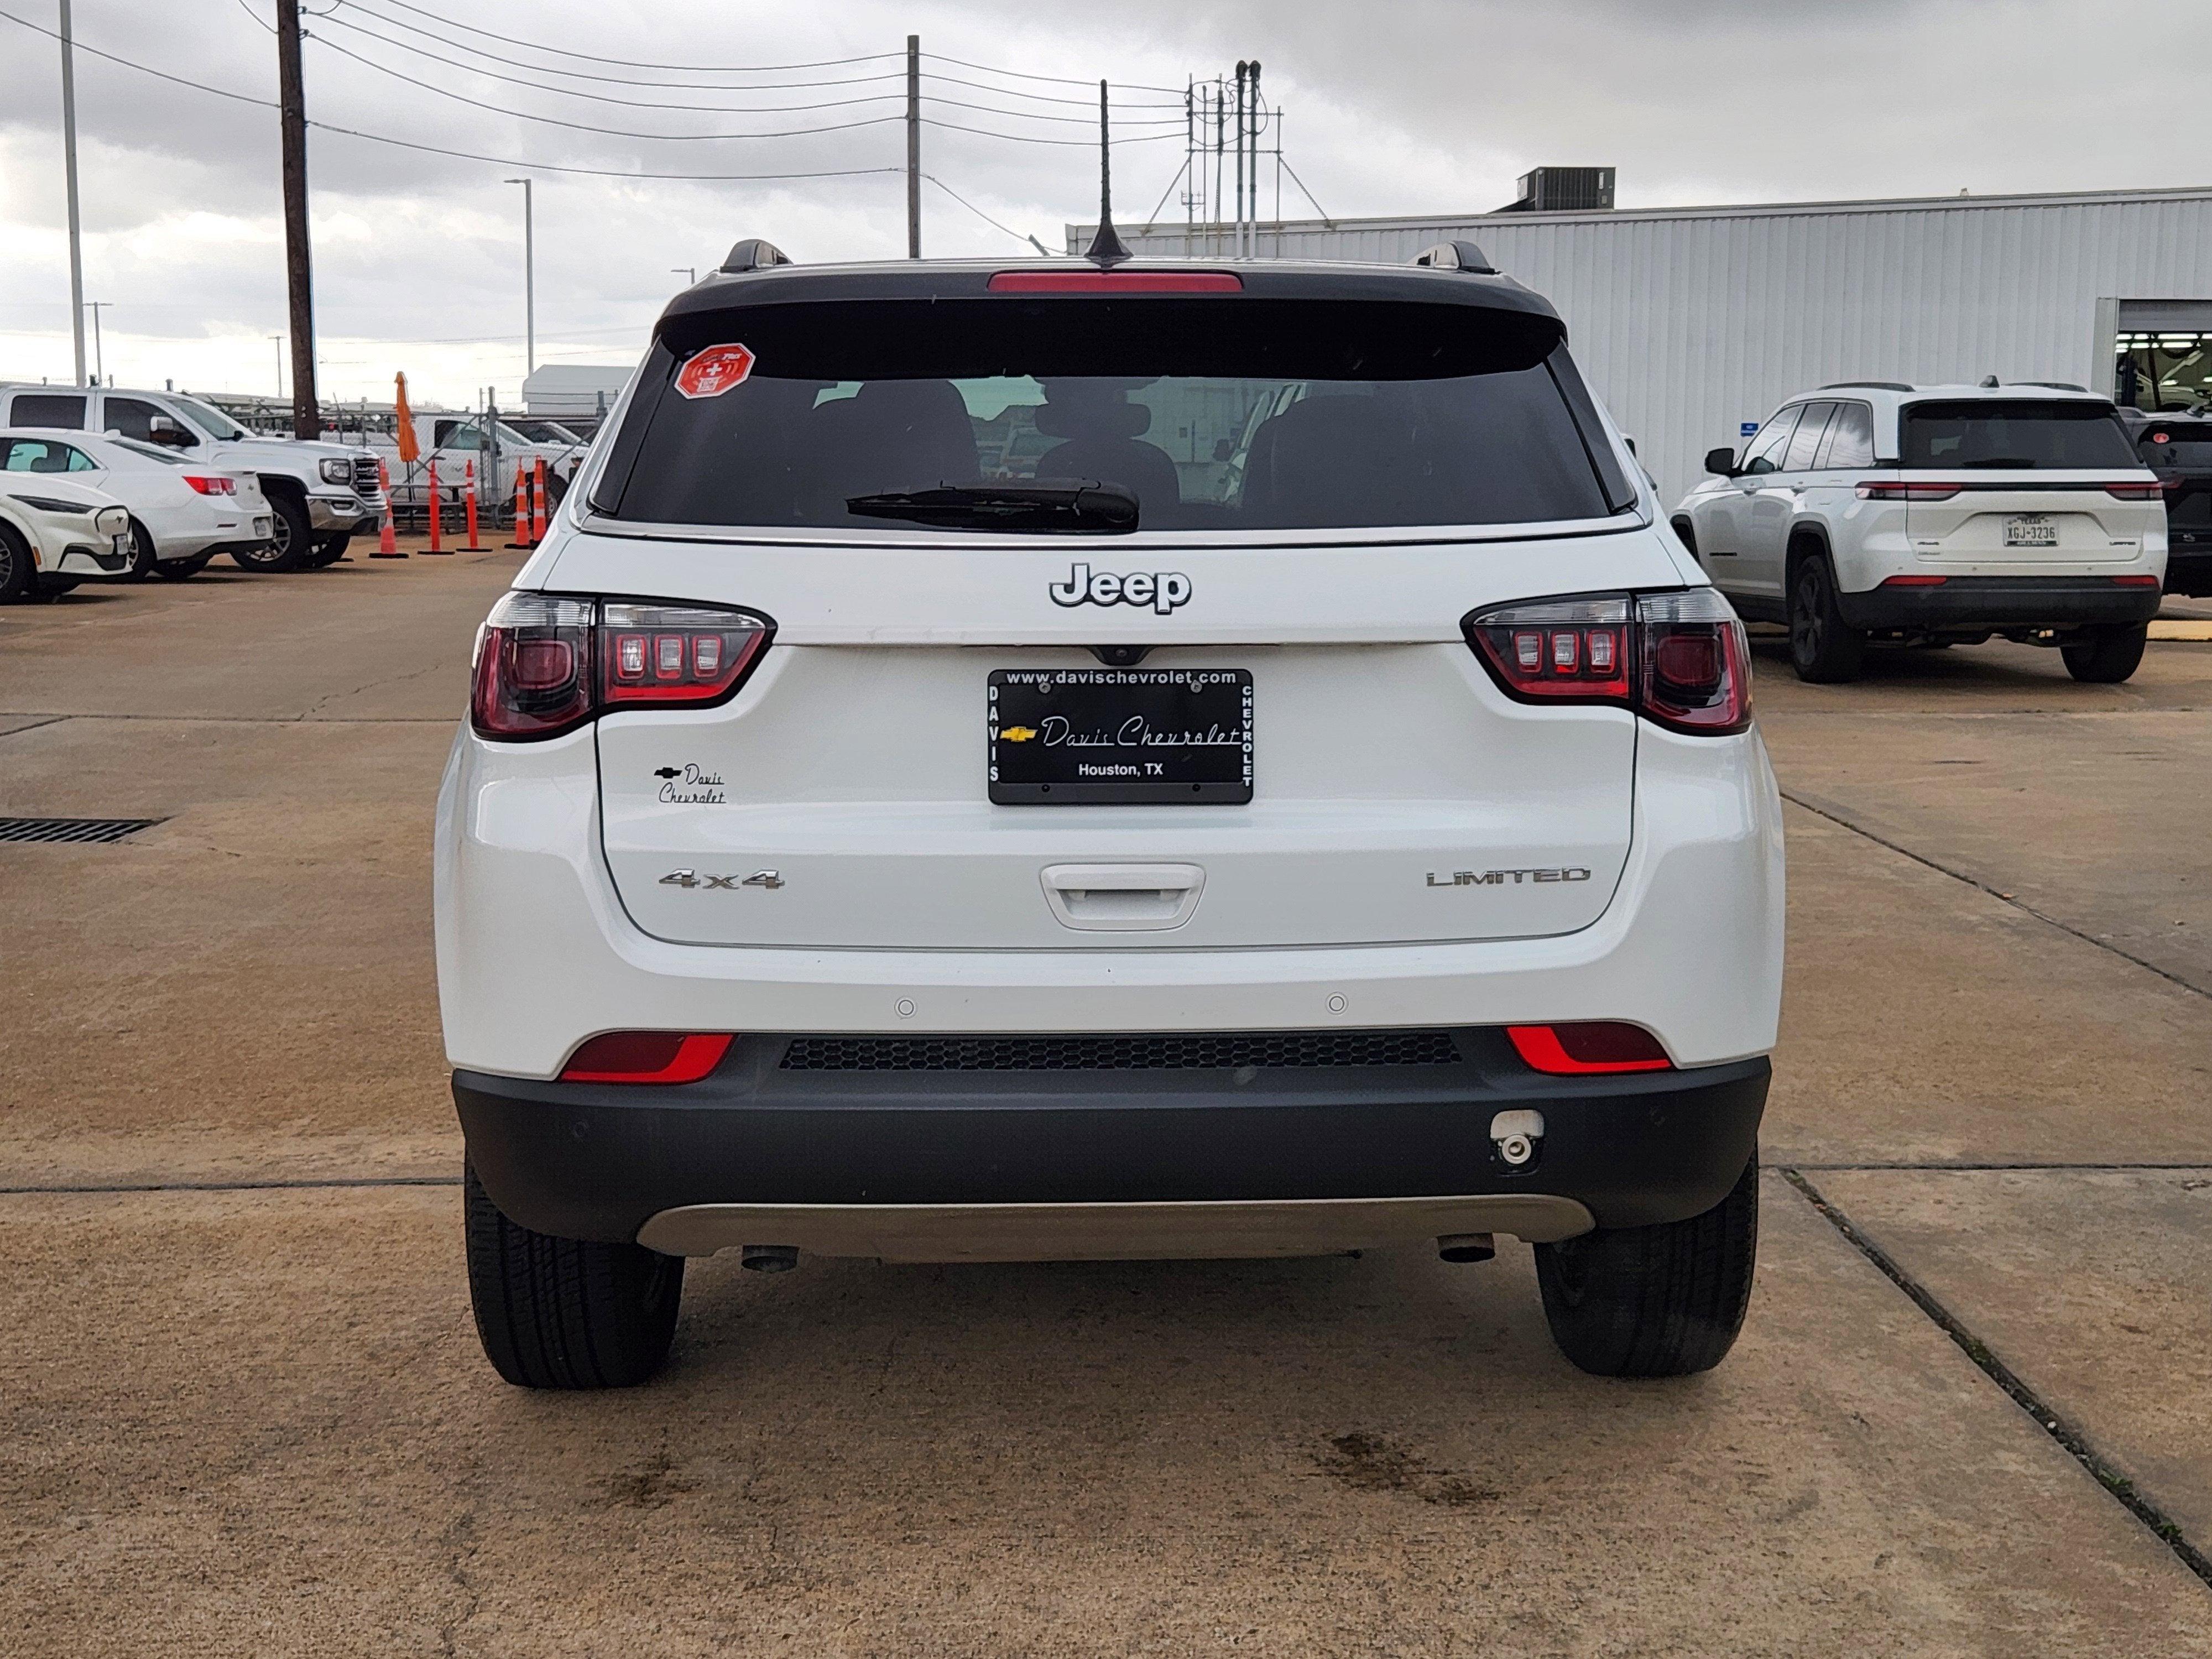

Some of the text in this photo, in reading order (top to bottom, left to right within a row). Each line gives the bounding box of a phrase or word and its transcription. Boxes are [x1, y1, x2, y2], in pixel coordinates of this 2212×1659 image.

[1049, 562, 1192, 615] Jeep
[1006, 671, 1237, 684] www.davischevrolet.com
[989, 686, 999, 782] DAVIS
[1041, 716, 1242, 747] Davis Chevrolet
[1242, 686, 1252, 787] CHEVROLET
[684, 763, 725, 785] Davis
[1079, 763, 1163, 777] Houston, TX
[659, 781, 727, 804] Chevrolet
[1426, 865, 1591, 886] LIMITED
